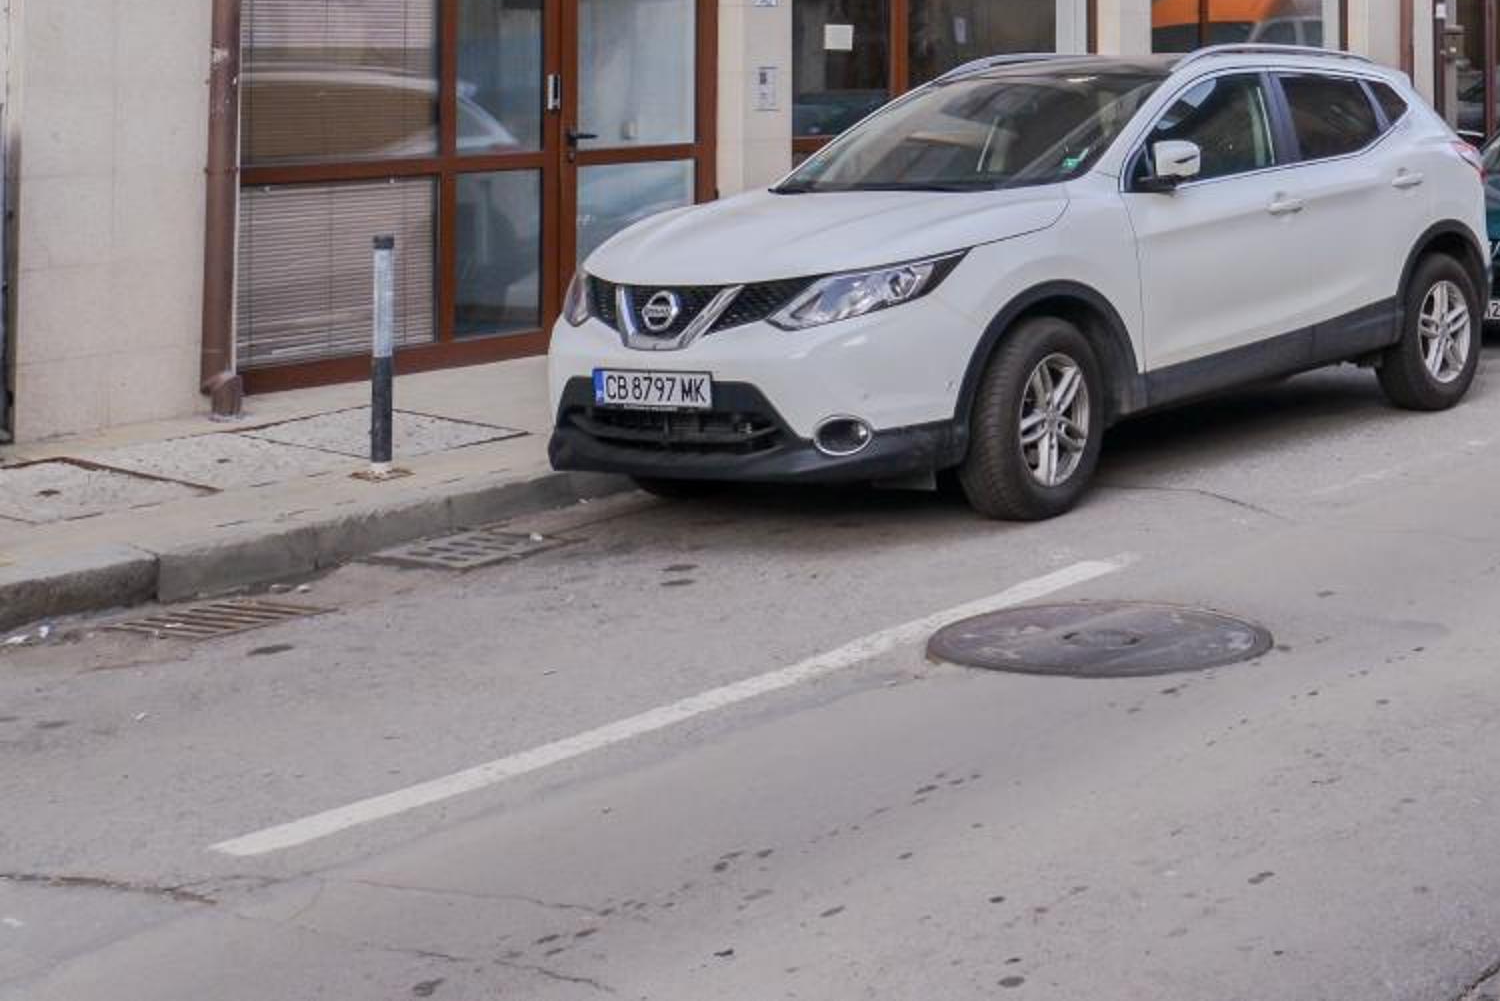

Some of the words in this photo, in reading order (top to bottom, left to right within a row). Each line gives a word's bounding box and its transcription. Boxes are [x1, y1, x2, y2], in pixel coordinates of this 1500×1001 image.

[605, 375, 629, 400] CB
[631, 376, 677, 402] 8797
[681, 378, 706, 403] MK
